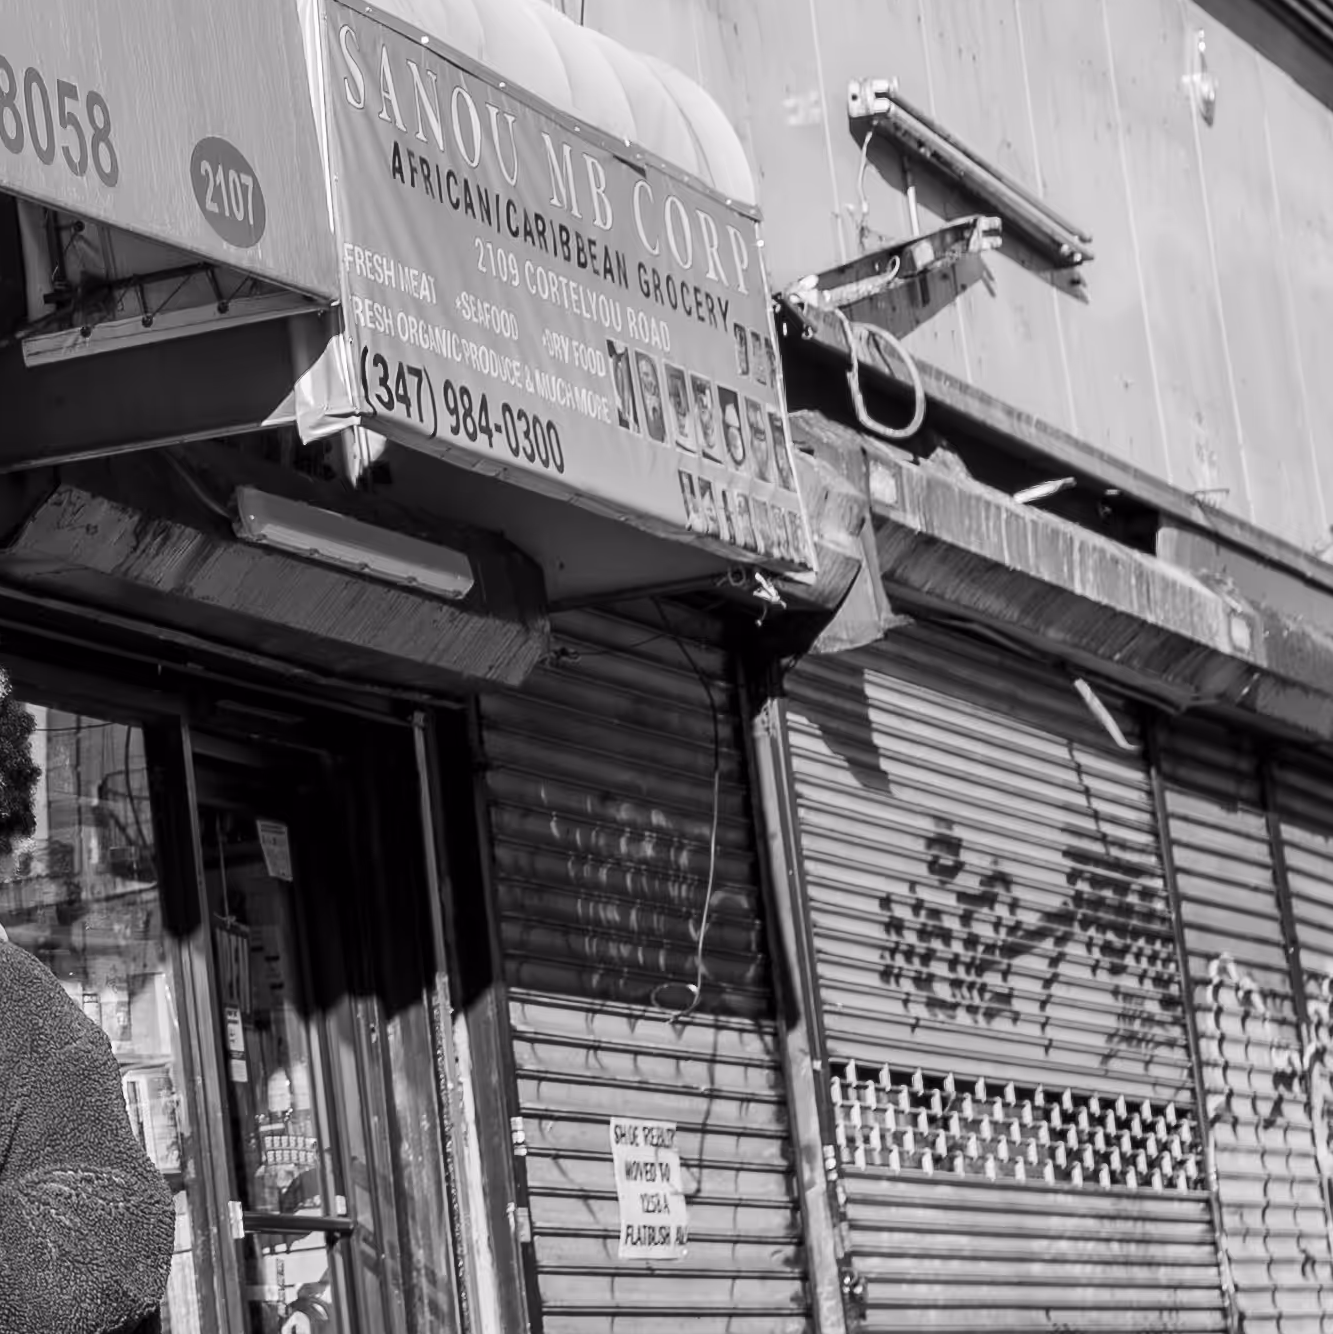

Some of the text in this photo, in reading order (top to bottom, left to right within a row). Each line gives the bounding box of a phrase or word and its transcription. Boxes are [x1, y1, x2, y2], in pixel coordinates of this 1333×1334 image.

[200, 159, 254, 226] 2107
[338, 24, 749, 296] SANOU MB CORP
[343, 242, 438, 305] FRESH MEAT
[474, 236, 671, 352] 2109 CORTELYOU ROAD
[637, 261, 730, 333] GROCERY
[396, 311, 462, 363] ORGANIC
[461, 338, 523, 389] PRODUCE
[524, 364, 535, 395] &
[572, 340, 607, 378] FOOD
[360, 345, 565, 474] (347) 984-0300
[624, 1224, 672, 1246] FLATBUSH
